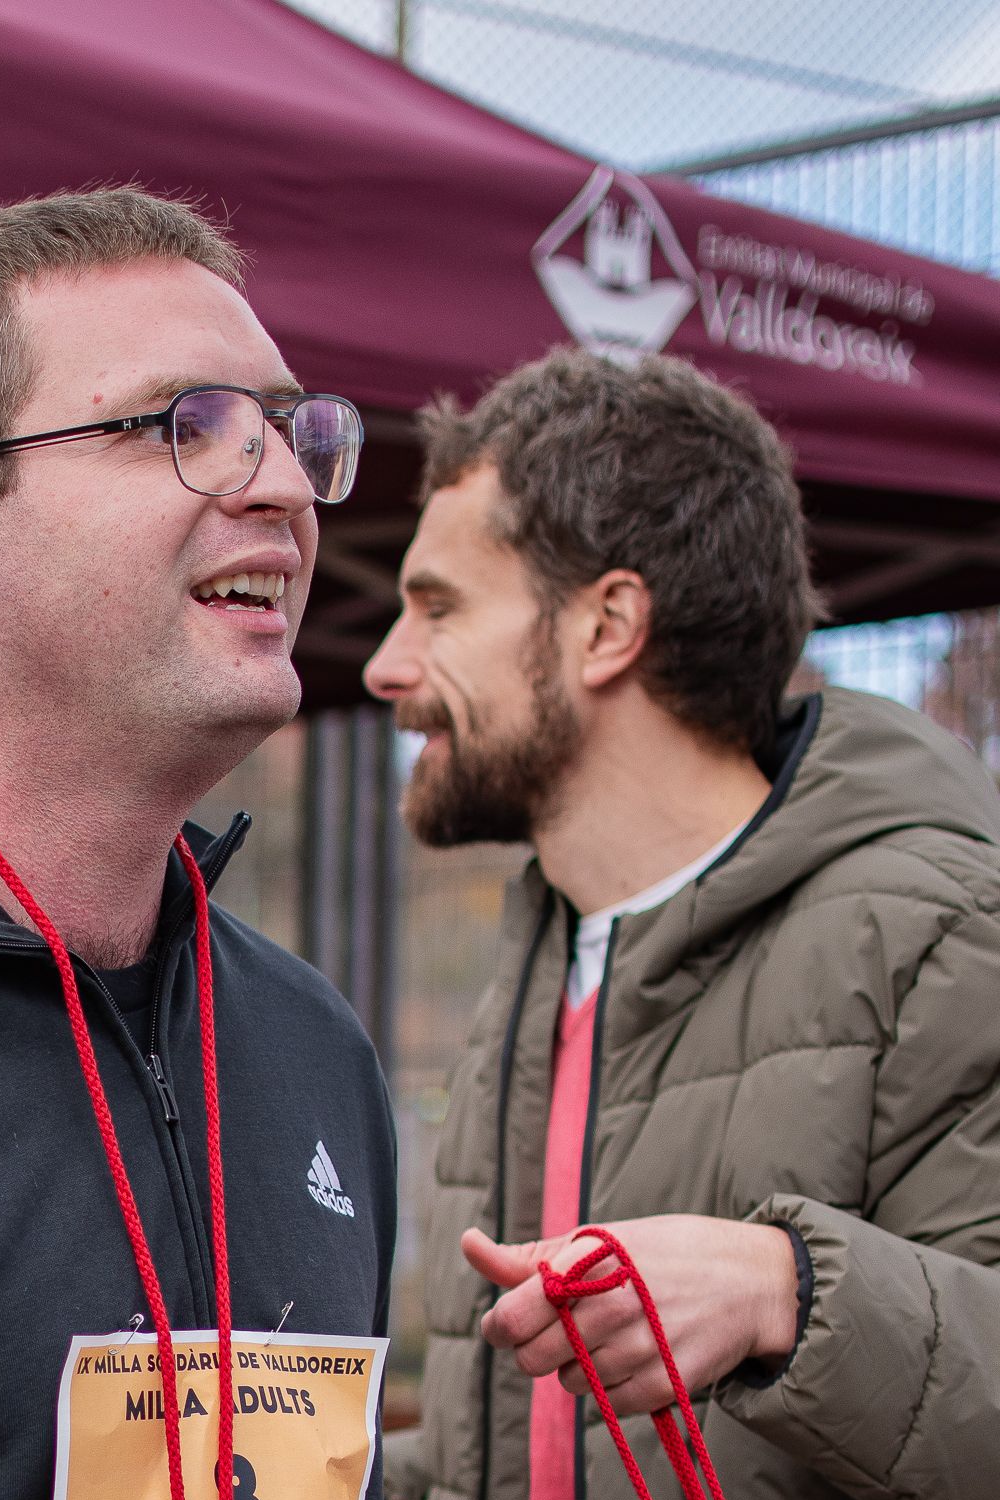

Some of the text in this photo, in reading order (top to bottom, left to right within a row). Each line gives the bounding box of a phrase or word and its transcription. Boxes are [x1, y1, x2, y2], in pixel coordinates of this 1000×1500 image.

[699, 269, 924, 388] Valldoreix
[307, 1183, 355, 1218] adidas
[76, 1356, 93, 1375] IX
[94, 1354, 142, 1375] MILLA
[236, 1351, 260, 1369] DE
[260, 1353, 367, 1376] VALLDOREIX
[125, 1387, 209, 1421] MILA
